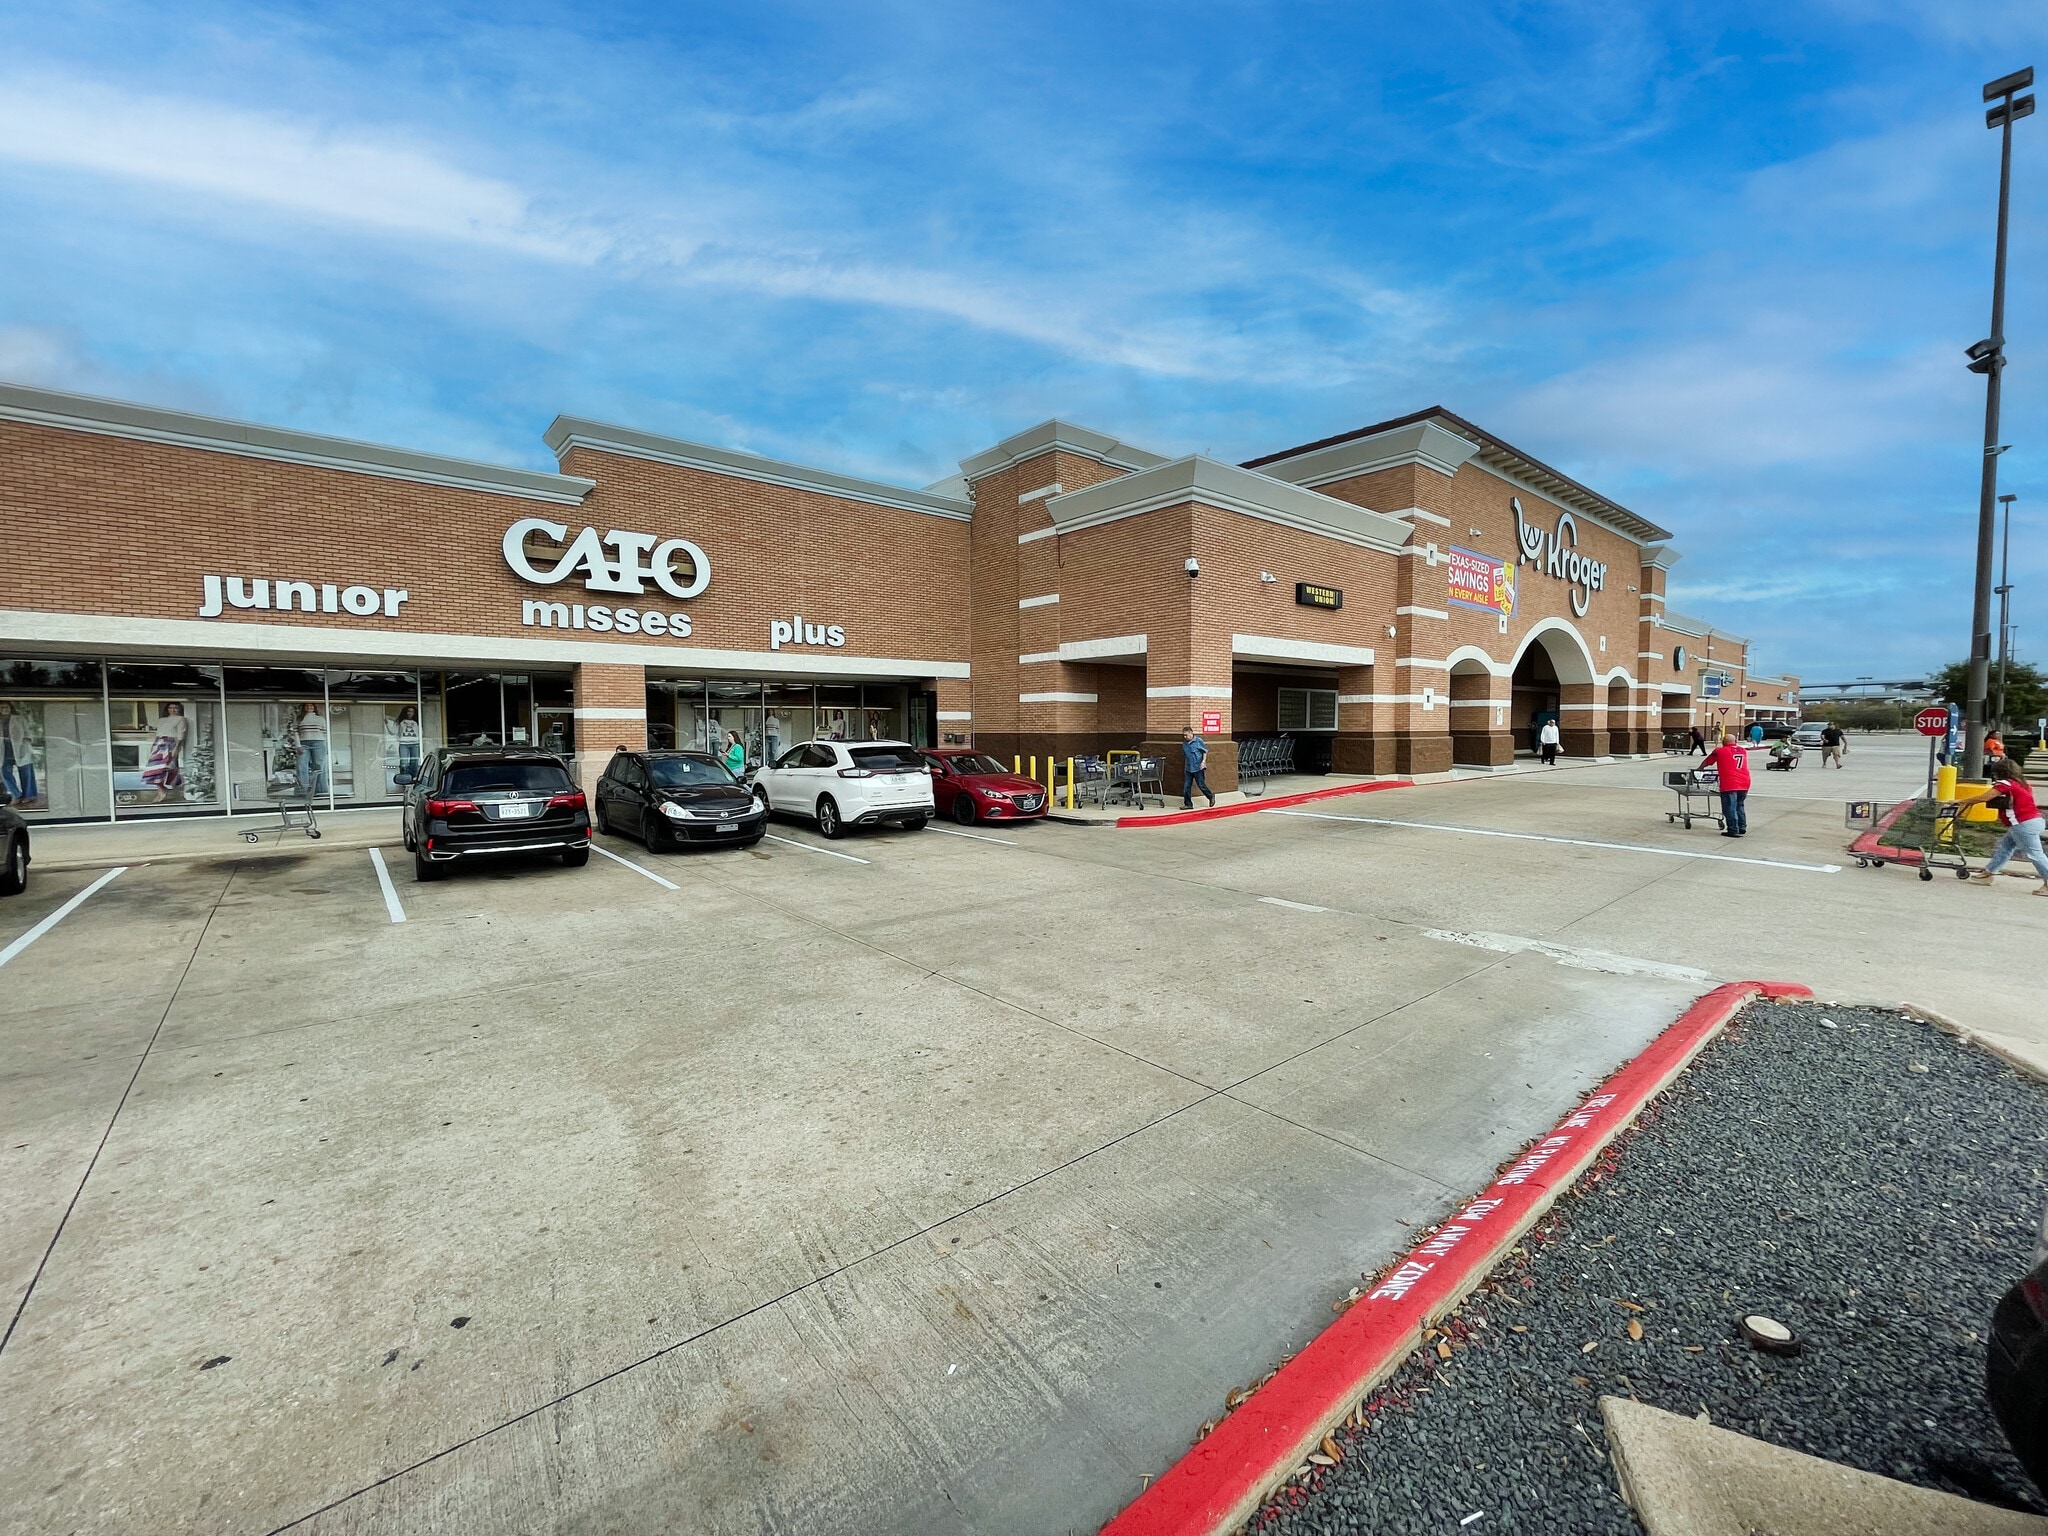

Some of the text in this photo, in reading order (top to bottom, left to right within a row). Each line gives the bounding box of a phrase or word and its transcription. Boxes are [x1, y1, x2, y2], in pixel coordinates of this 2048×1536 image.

[502, 518, 711, 599] CATO
[1449, 552, 1490, 575] TEXAS-SIZED
[1546, 511, 1607, 618] Kroger
[199, 574, 409, 619] junior
[1305, 585, 1334, 598] WESTERN
[1448, 566, 1489, 593] SAVINGS
[1454, 588, 1473, 601] EVERY
[1473, 592, 1489, 605] AISLE
[1314, 595, 1334, 605] UNION
[522, 599, 692, 638] misses
[770, 615, 847, 651] plus
[1733, 753, 1744, 770] 7
[1496, 1135, 1573, 1186] NO PARKING
[1369, 1197, 1504, 1301] TOW AWAY ZONE
